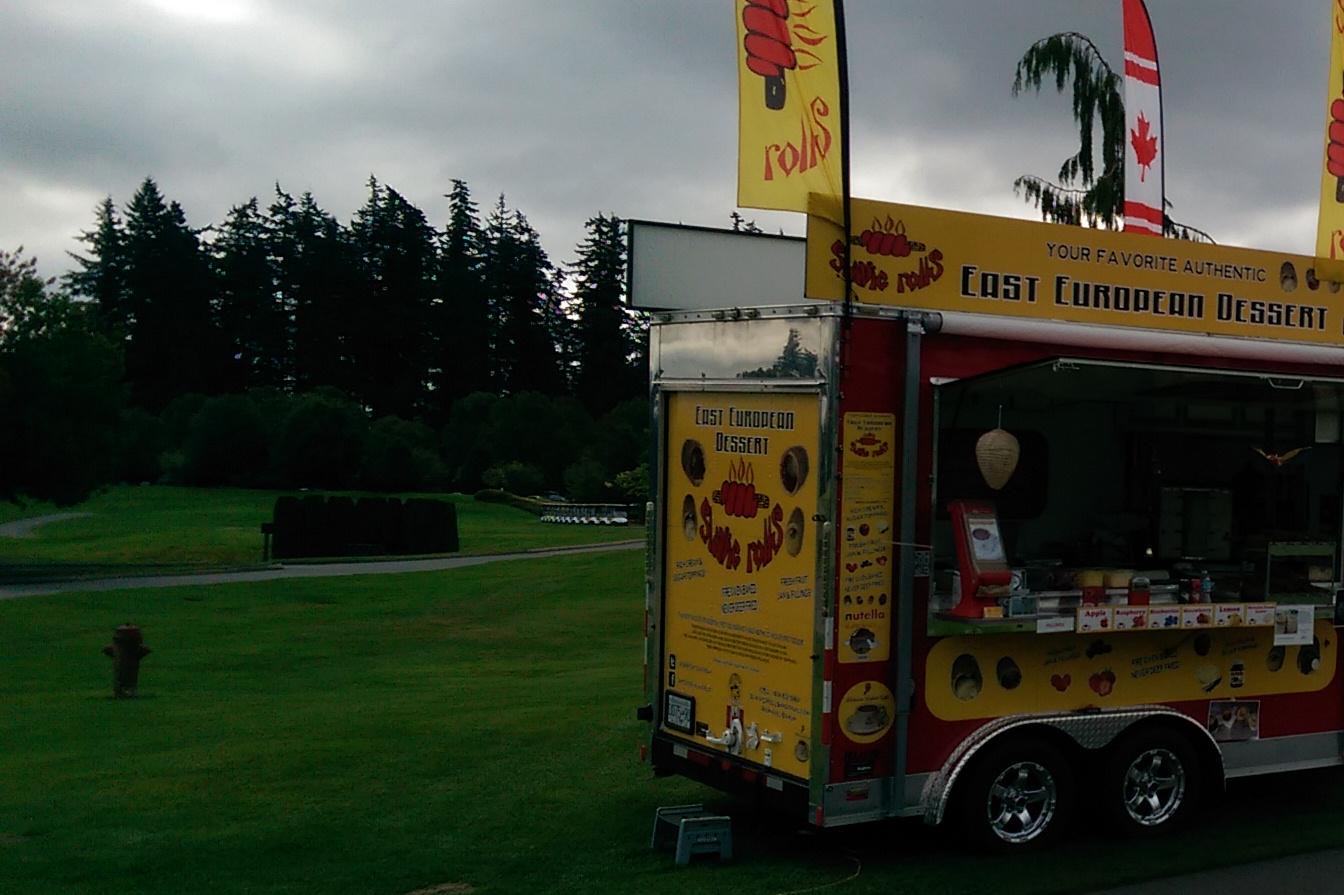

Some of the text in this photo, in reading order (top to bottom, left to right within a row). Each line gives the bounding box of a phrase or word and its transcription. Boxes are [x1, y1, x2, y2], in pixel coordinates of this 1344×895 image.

[763, 95, 832, 181] rolls
[1046, 242, 1268, 282] YOUR FAVORITE AUTHENTIC
[845, 609, 885, 621] nutella
